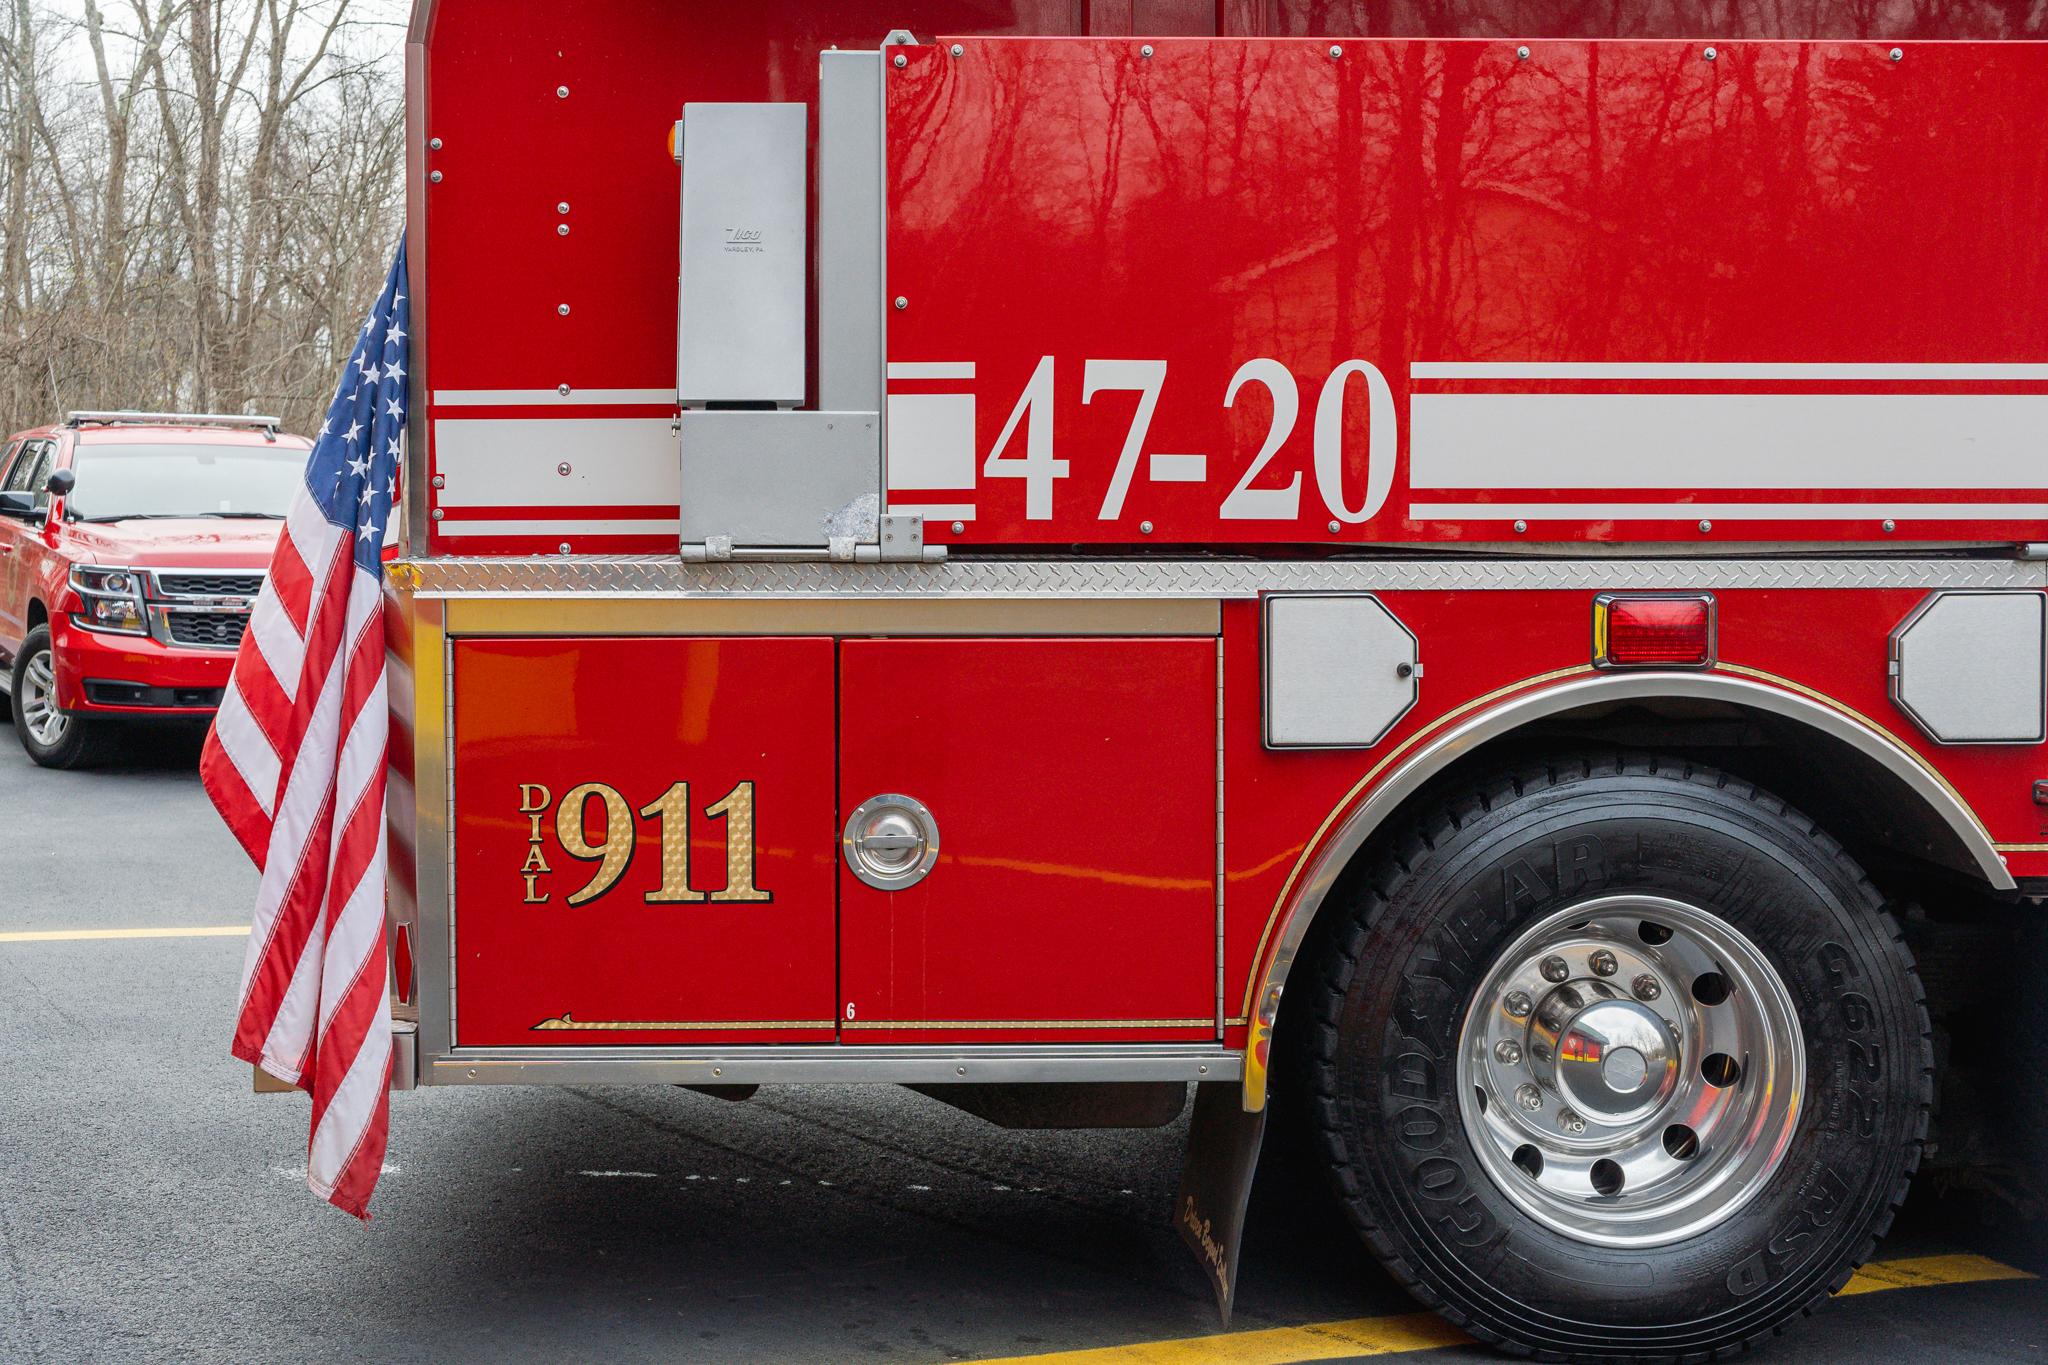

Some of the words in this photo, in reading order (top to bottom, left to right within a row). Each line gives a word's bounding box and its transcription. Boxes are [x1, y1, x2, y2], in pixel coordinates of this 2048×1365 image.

[984, 356, 1397, 523] 47-20
[519, 784, 551, 905] DIAL
[555, 780, 773, 908] 911
[846, 1002, 855, 1020] 6
